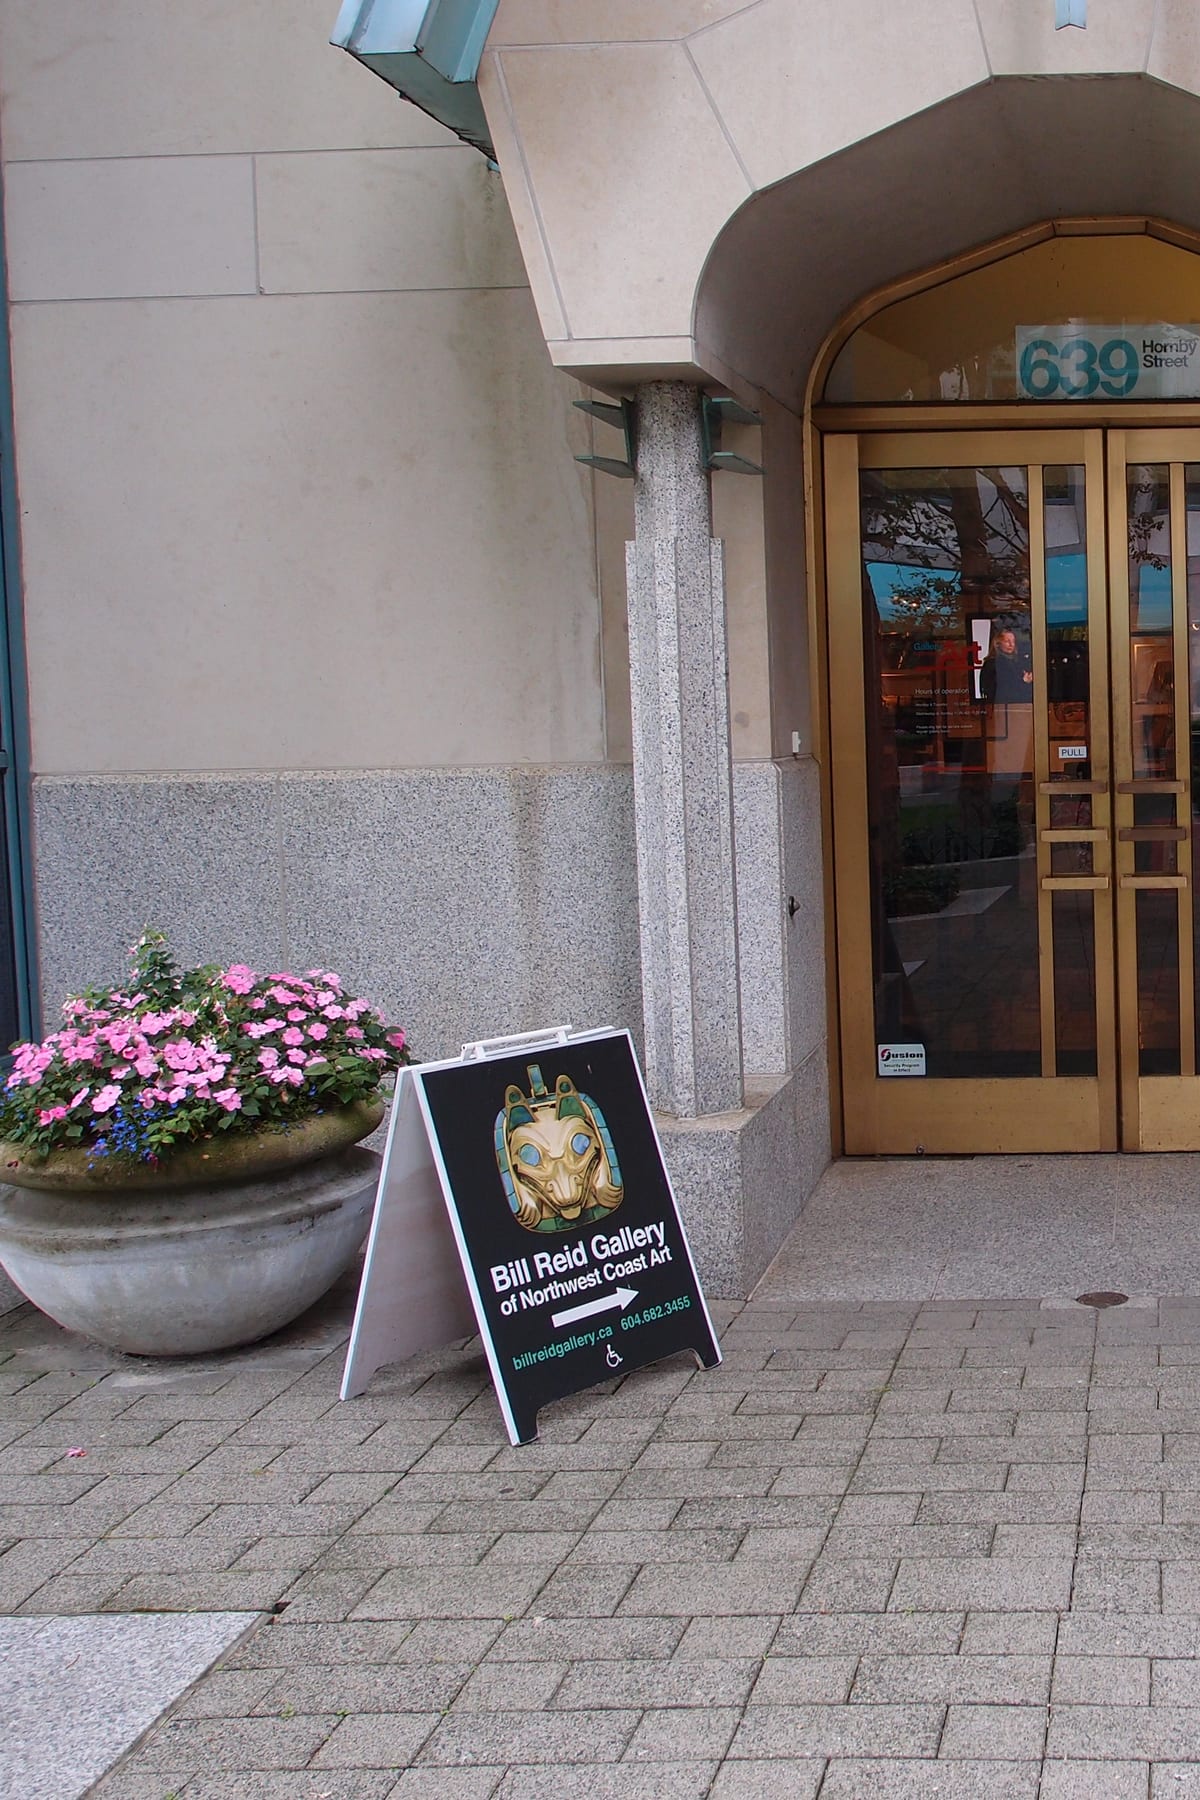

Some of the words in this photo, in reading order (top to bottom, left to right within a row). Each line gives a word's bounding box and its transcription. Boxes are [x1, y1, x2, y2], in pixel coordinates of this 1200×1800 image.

[1019, 339, 1139, 397] 639
[1142, 339, 1198, 355] Hornby
[1142, 355, 1189, 368] Street
[1061, 748, 1085, 757] PULL
[490, 1258, 532, 1293] Bill
[533, 1240, 588, 1279] Reid
[591, 1221, 667, 1260] Gallery
[500, 1293, 519, 1316] of
[520, 1269, 603, 1310] Northwest
[603, 1252, 649, 1281] Coast
[650, 1245, 673, 1267] Art
[512, 1325, 614, 1371] billreidgallery.ca
[620, 1295, 692, 1331] 604.682.3455
